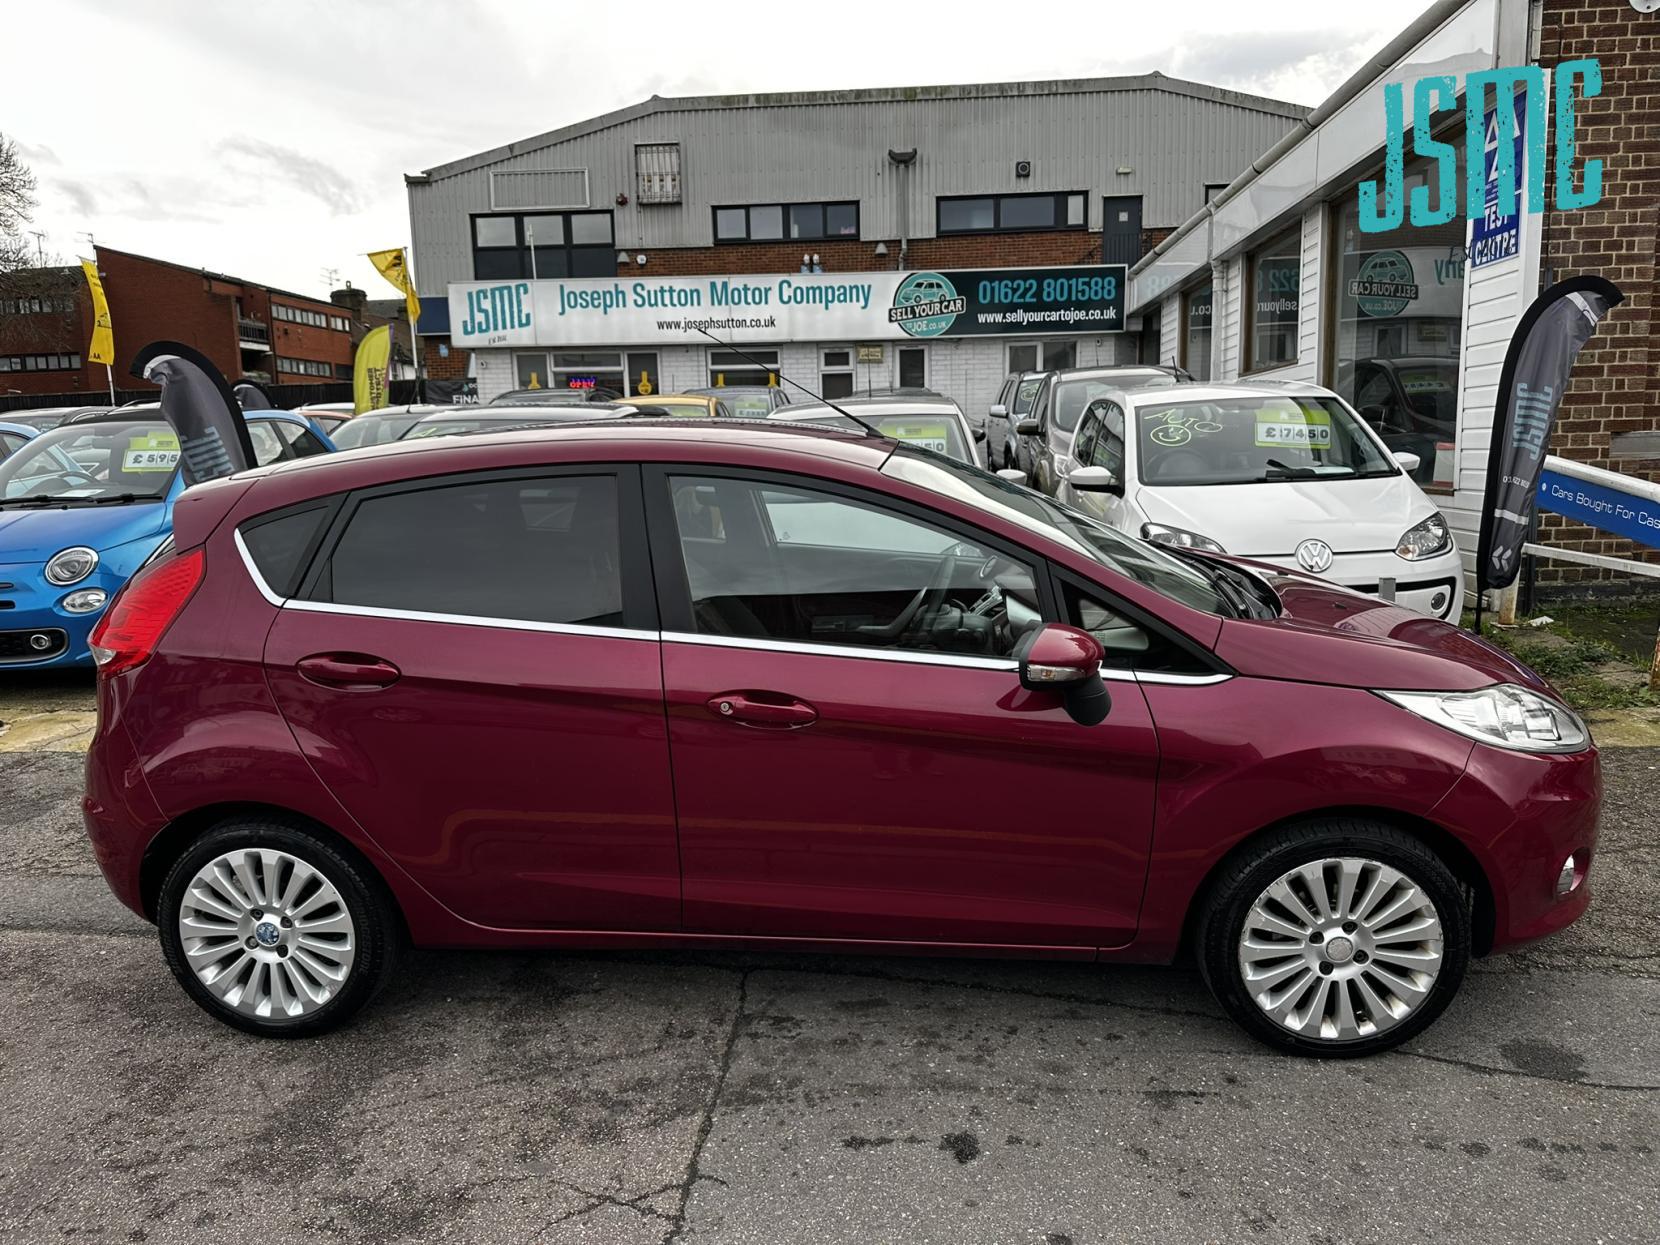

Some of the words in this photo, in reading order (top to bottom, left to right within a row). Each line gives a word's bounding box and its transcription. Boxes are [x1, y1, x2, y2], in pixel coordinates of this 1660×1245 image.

[559, 283, 626, 315] Joseph
[632, 282, 701, 307] Sutton
[709, 281, 772, 306] Motor
[778, 279, 872, 310] Company
[978, 279, 1038, 304] 01622
[1042, 276, 1116, 302] 801588
[462, 283, 531, 336] JSMC
[890, 307, 913, 321] SELL
[914, 303, 941, 317] YOUR
[941, 299, 962, 313] CAR
[977, 306, 1117, 325] www.sellyourcartojoe.co.uk
[656, 316, 776, 333] www.josephsutton.co.uk
[1143, 408, 1223, 433] AUTO
[1551, 484, 1574, 501] Cars
[1575, 492, 1613, 513] Bought
[1615, 504, 1635, 519] For
